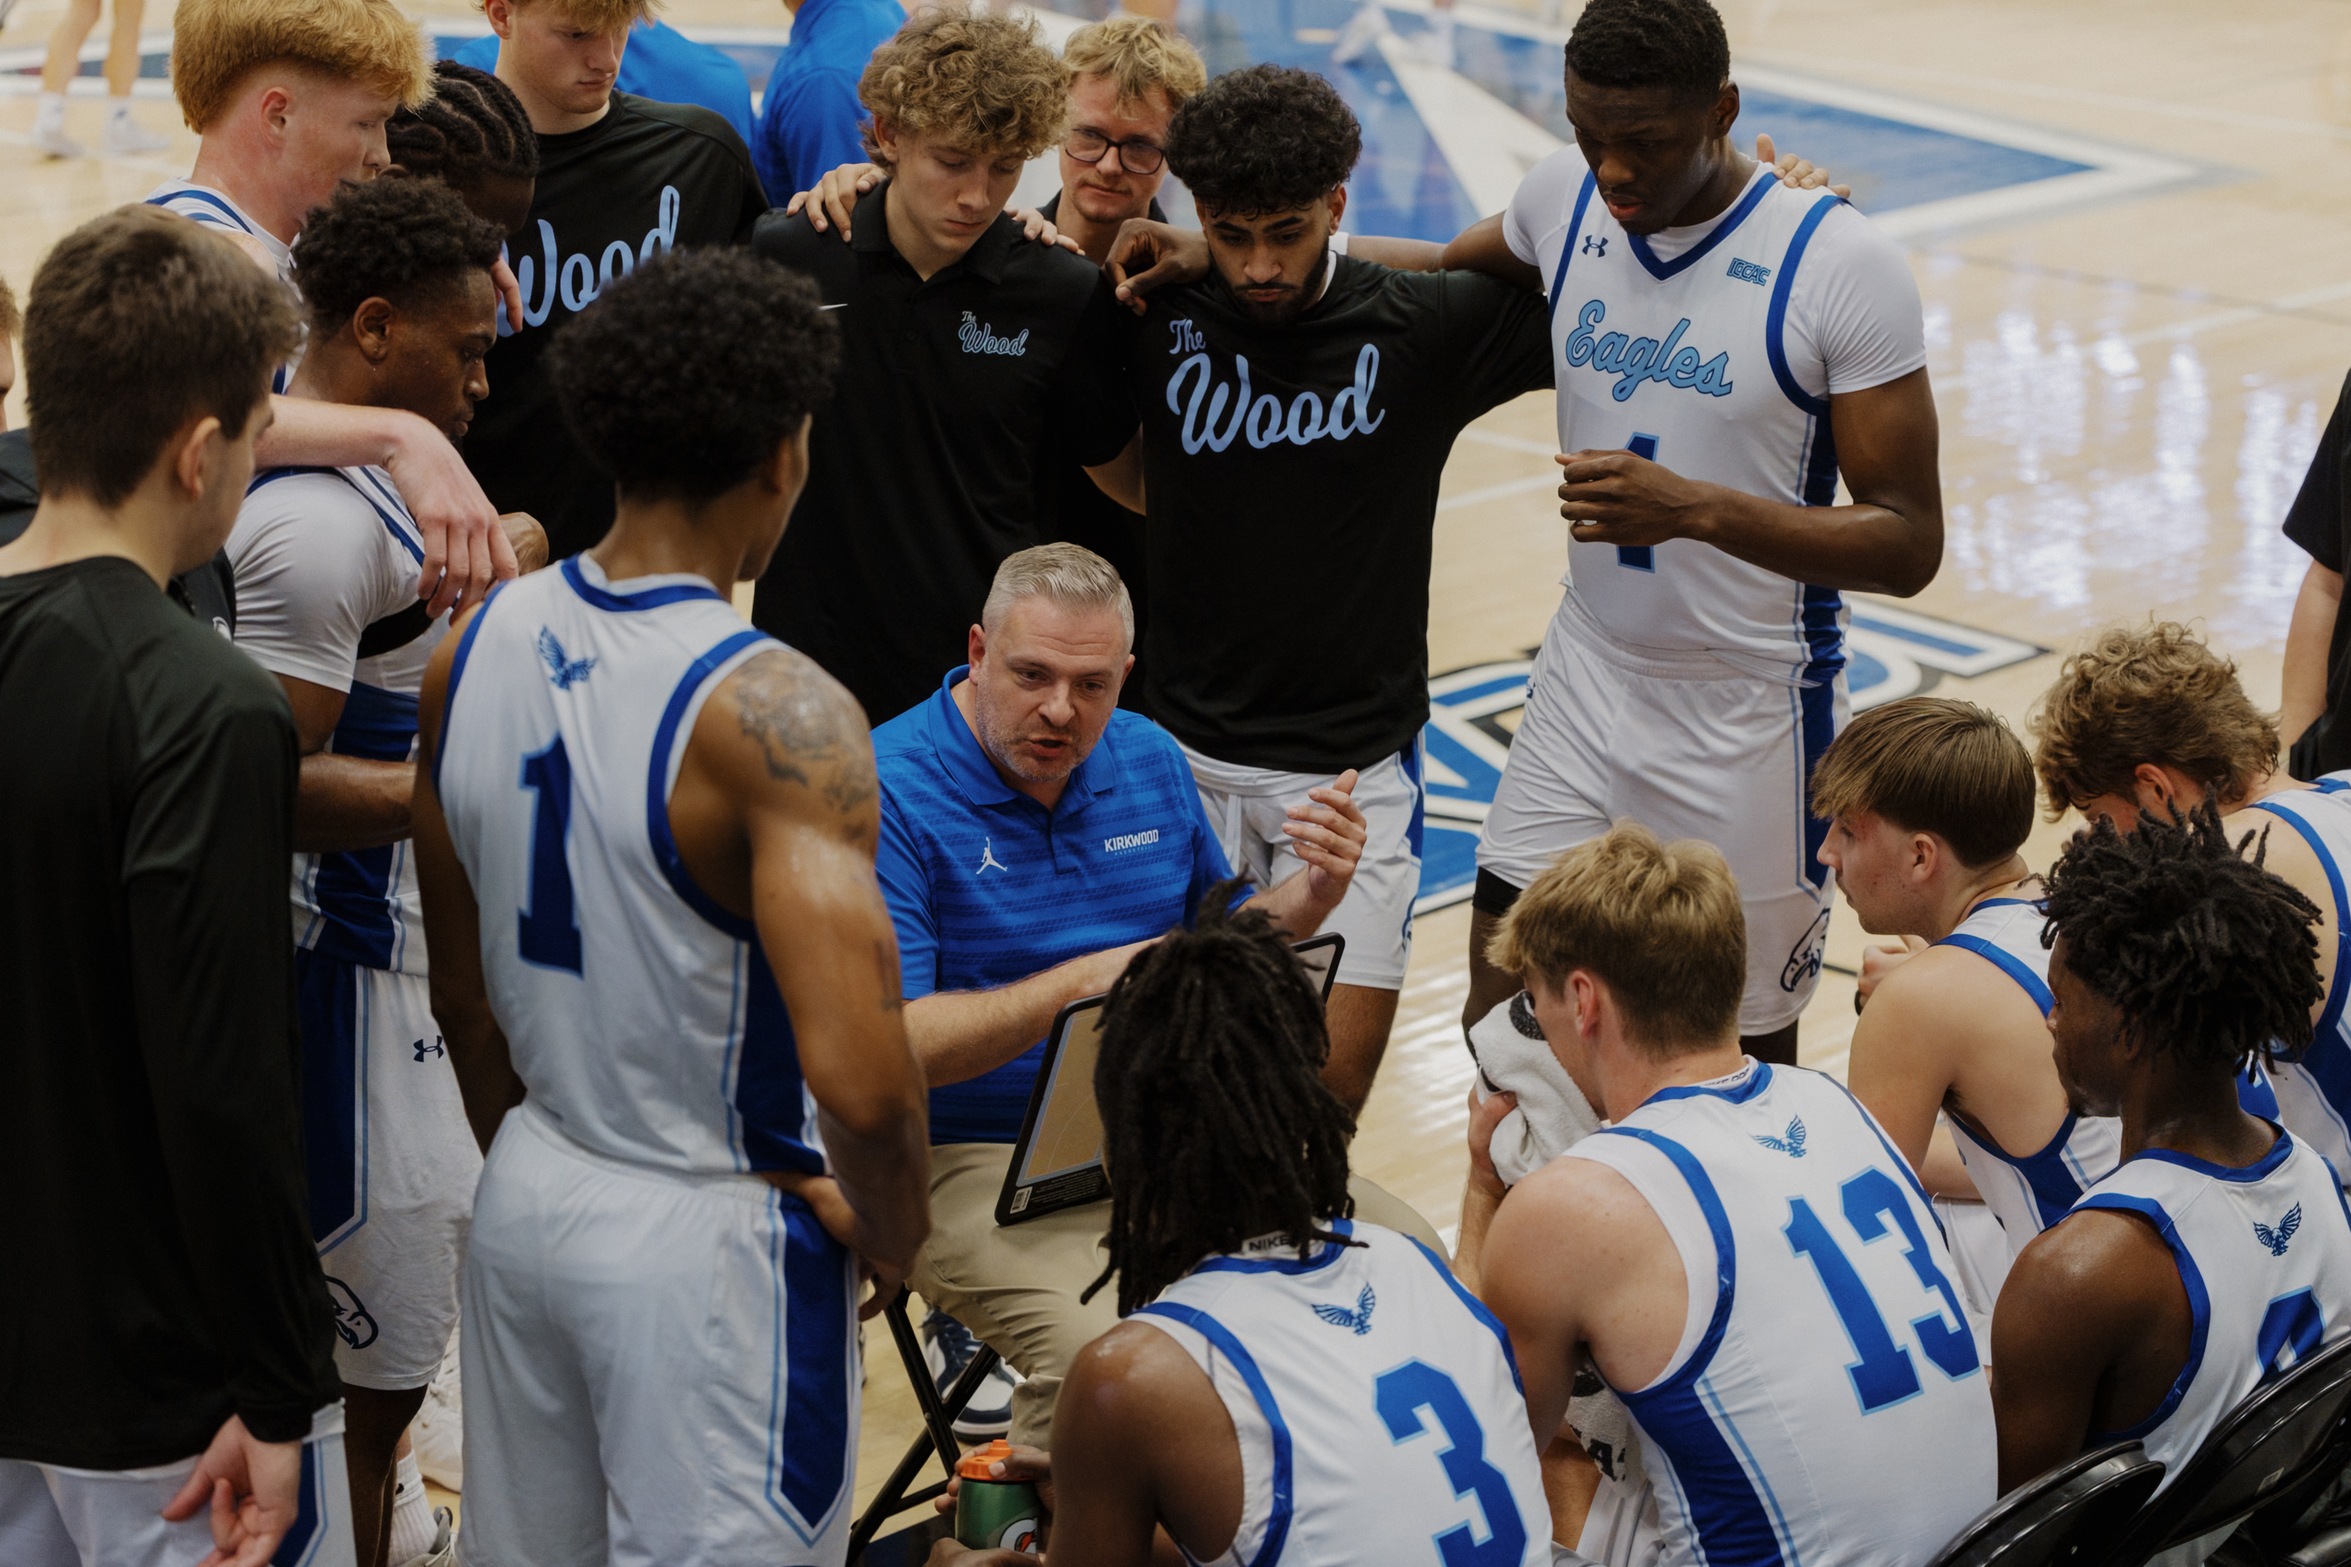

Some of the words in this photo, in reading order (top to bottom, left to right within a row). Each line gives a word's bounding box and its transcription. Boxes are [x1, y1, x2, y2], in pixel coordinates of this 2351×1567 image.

[958, 321, 1029, 356] Wood
[962, 310, 977, 322] The
[1168, 318, 1206, 354] The
[1566, 299, 1733, 402] Eagles
[1166, 343, 1386, 455] Wood
[517, 731, 585, 979] 1
[1104, 829, 1159, 853] KIRKWOOD
[1779, 1164, 1982, 1417] 13
[1373, 1357, 1527, 1567] 3
